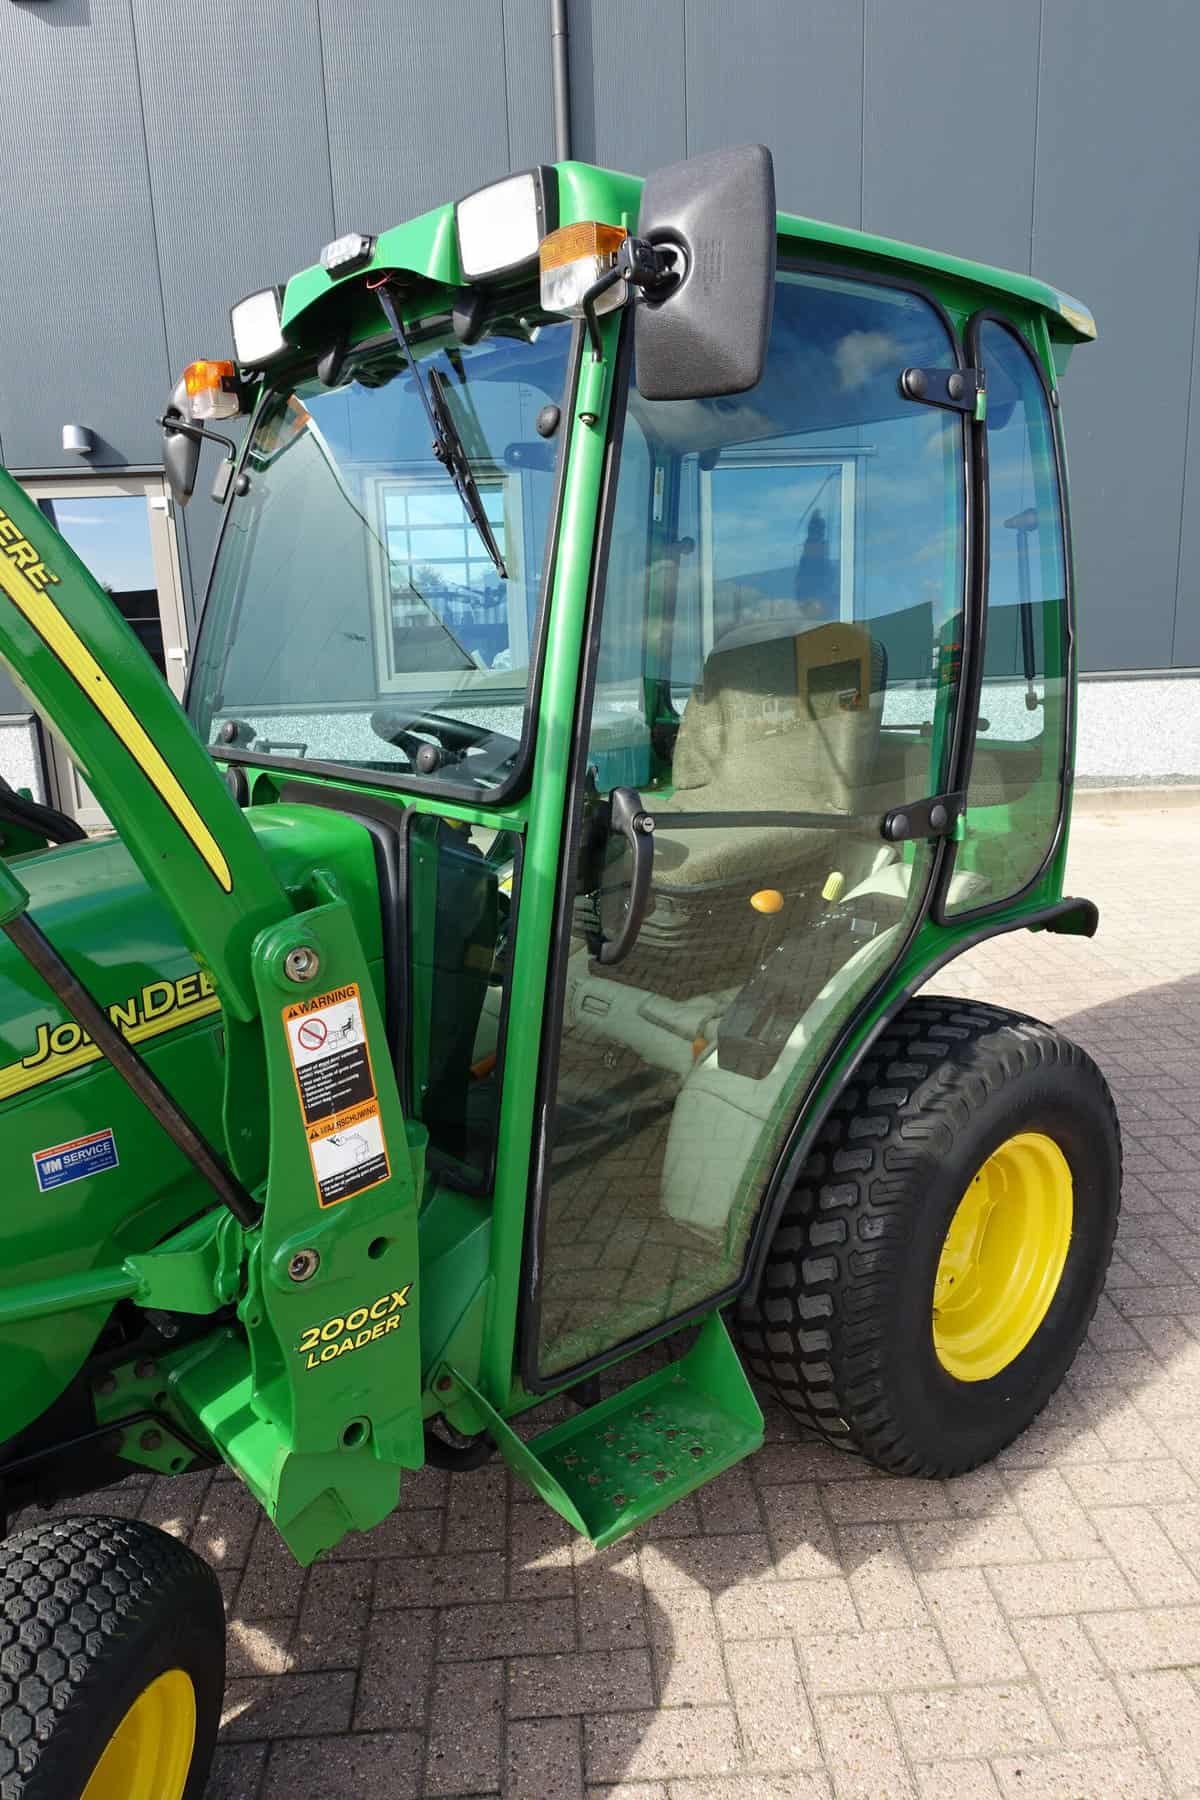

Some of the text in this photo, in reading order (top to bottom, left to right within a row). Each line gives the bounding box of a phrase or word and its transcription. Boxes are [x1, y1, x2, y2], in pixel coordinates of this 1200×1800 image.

[0, 508, 61, 592] ERE
[299, 986, 356, 1014] WARNING
[22, 999, 139, 1068] JON
[41, 1158, 63, 1176] VM
[63, 1141, 112, 1165] SERVICE
[298, 1282, 413, 1353] 200CX
[305, 1314, 401, 1371] LOADER
